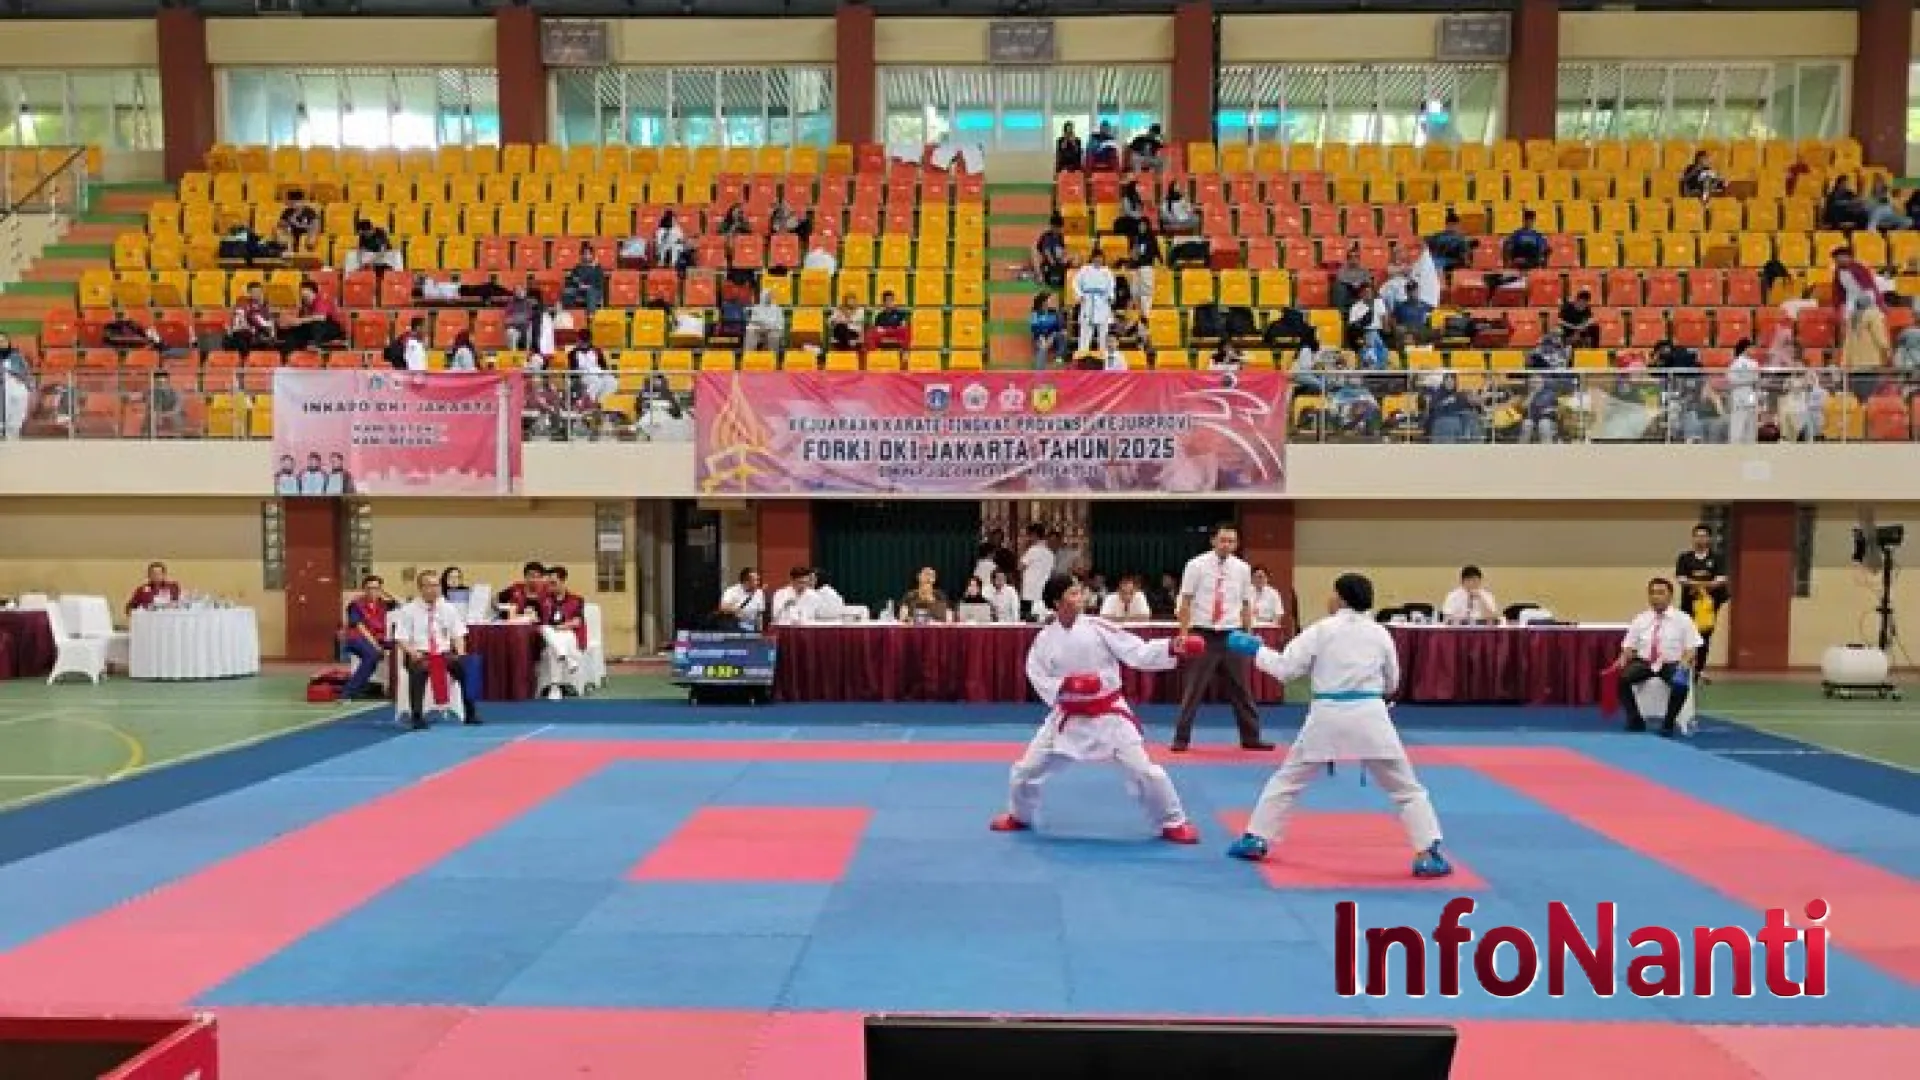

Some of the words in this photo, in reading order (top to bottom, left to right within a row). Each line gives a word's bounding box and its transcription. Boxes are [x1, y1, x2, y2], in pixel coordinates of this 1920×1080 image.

[788, 418, 879, 431] KEJUARAAN
[883, 418, 940, 431] KARATE
[948, 417, 1011, 431] TINGKAT
[803, 439, 870, 461] FORKI
[879, 440, 917, 461] DKI
[926, 439, 1028, 461] JAKARTA
[1039, 438, 1109, 459] TAHUN
[1118, 438, 1175, 459] 2025
